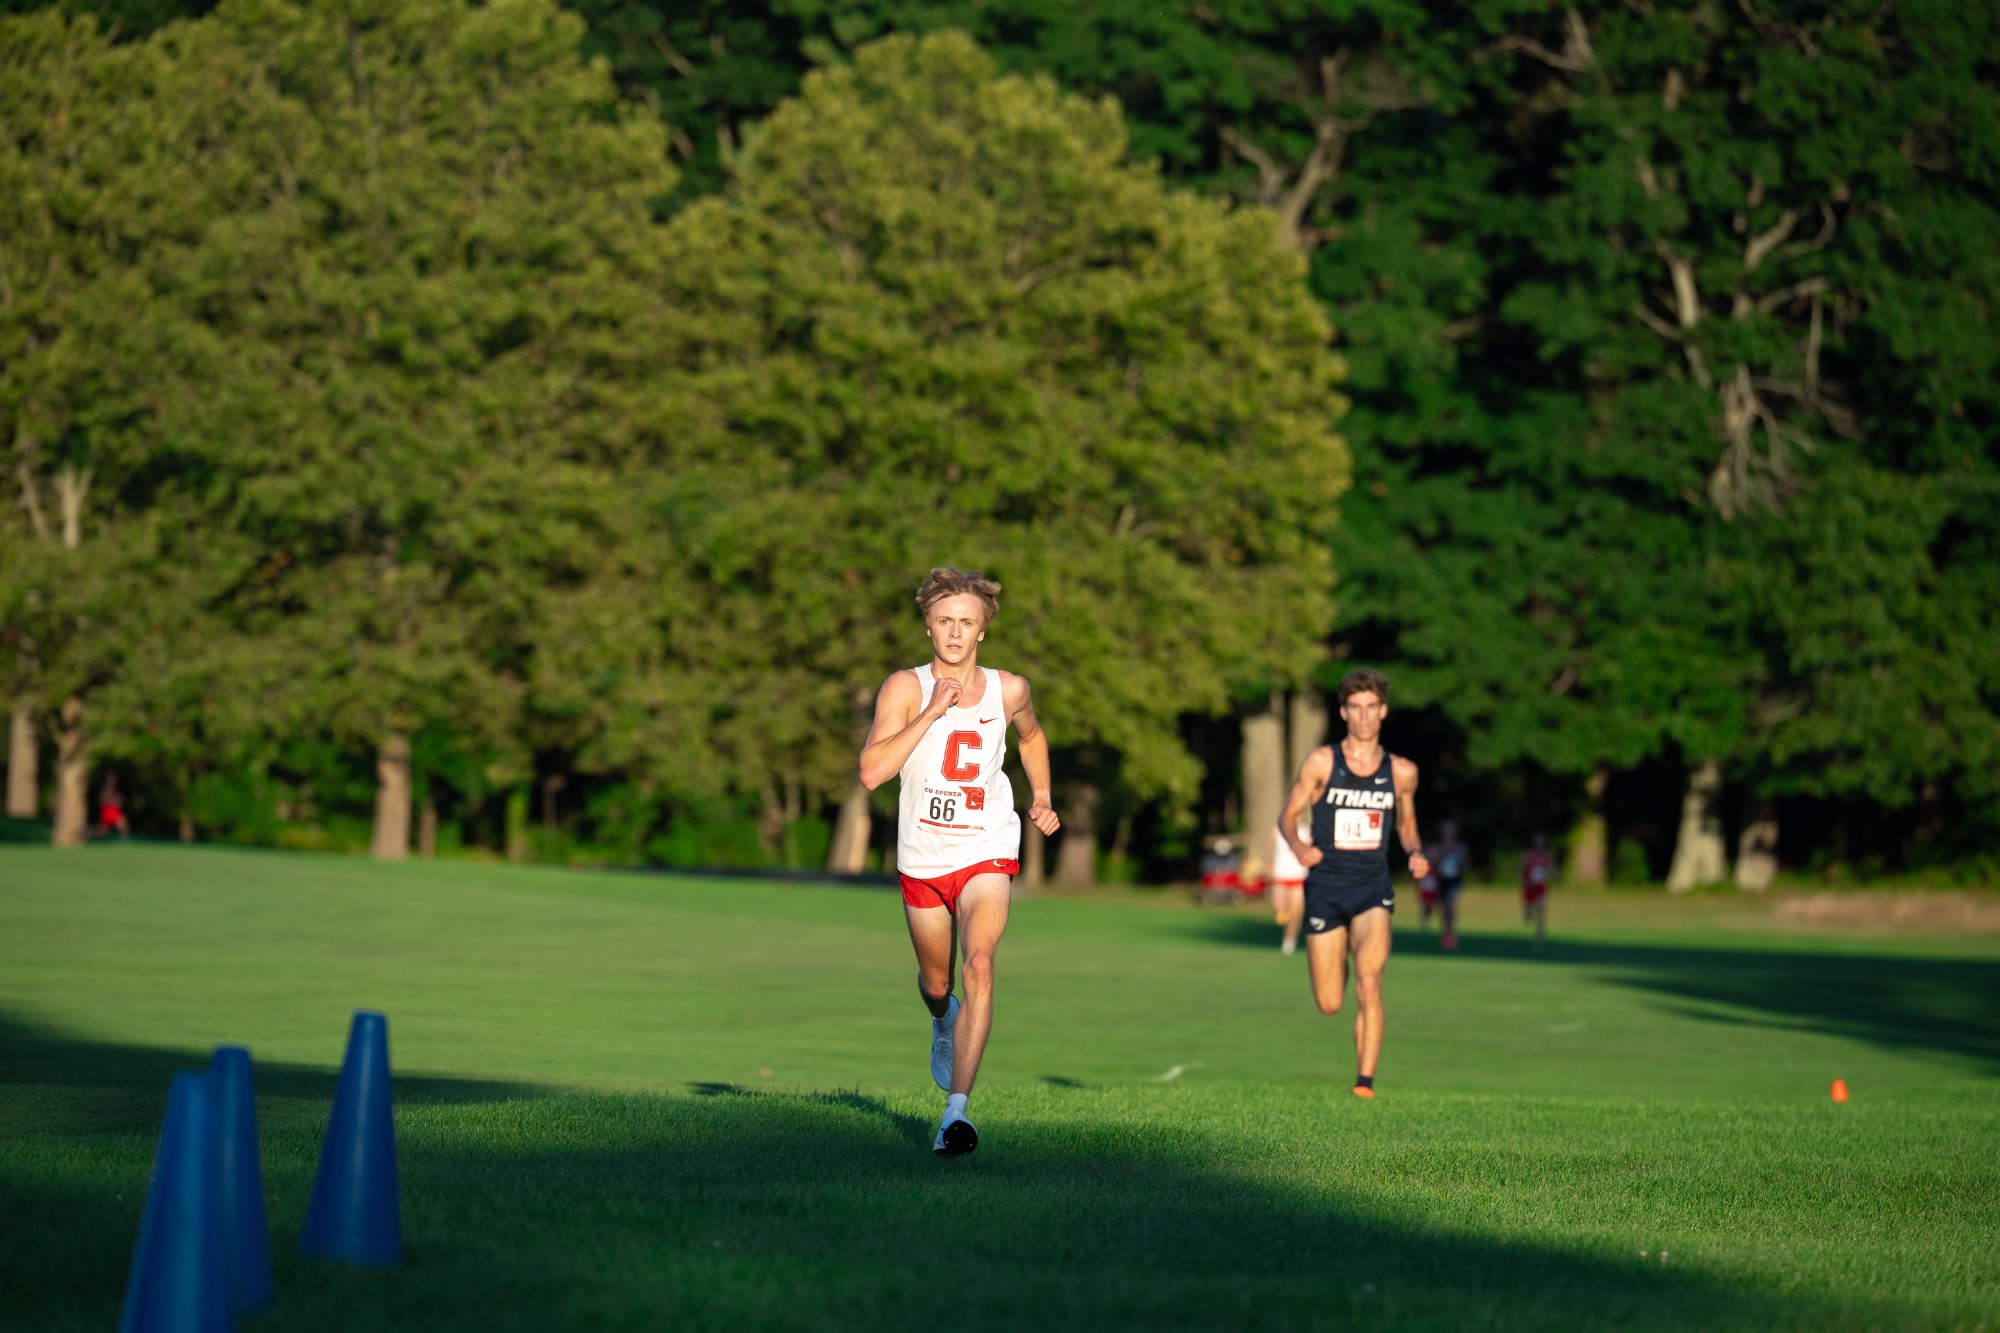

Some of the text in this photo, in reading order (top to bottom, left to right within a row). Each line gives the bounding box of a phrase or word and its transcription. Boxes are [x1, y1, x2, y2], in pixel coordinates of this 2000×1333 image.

[941, 730, 982, 782] C
[935, 789, 962, 797] OPENER
[1326, 787, 1394, 809] ITHACA
[929, 796, 956, 822] 66
[1342, 822, 1361, 838] 94
